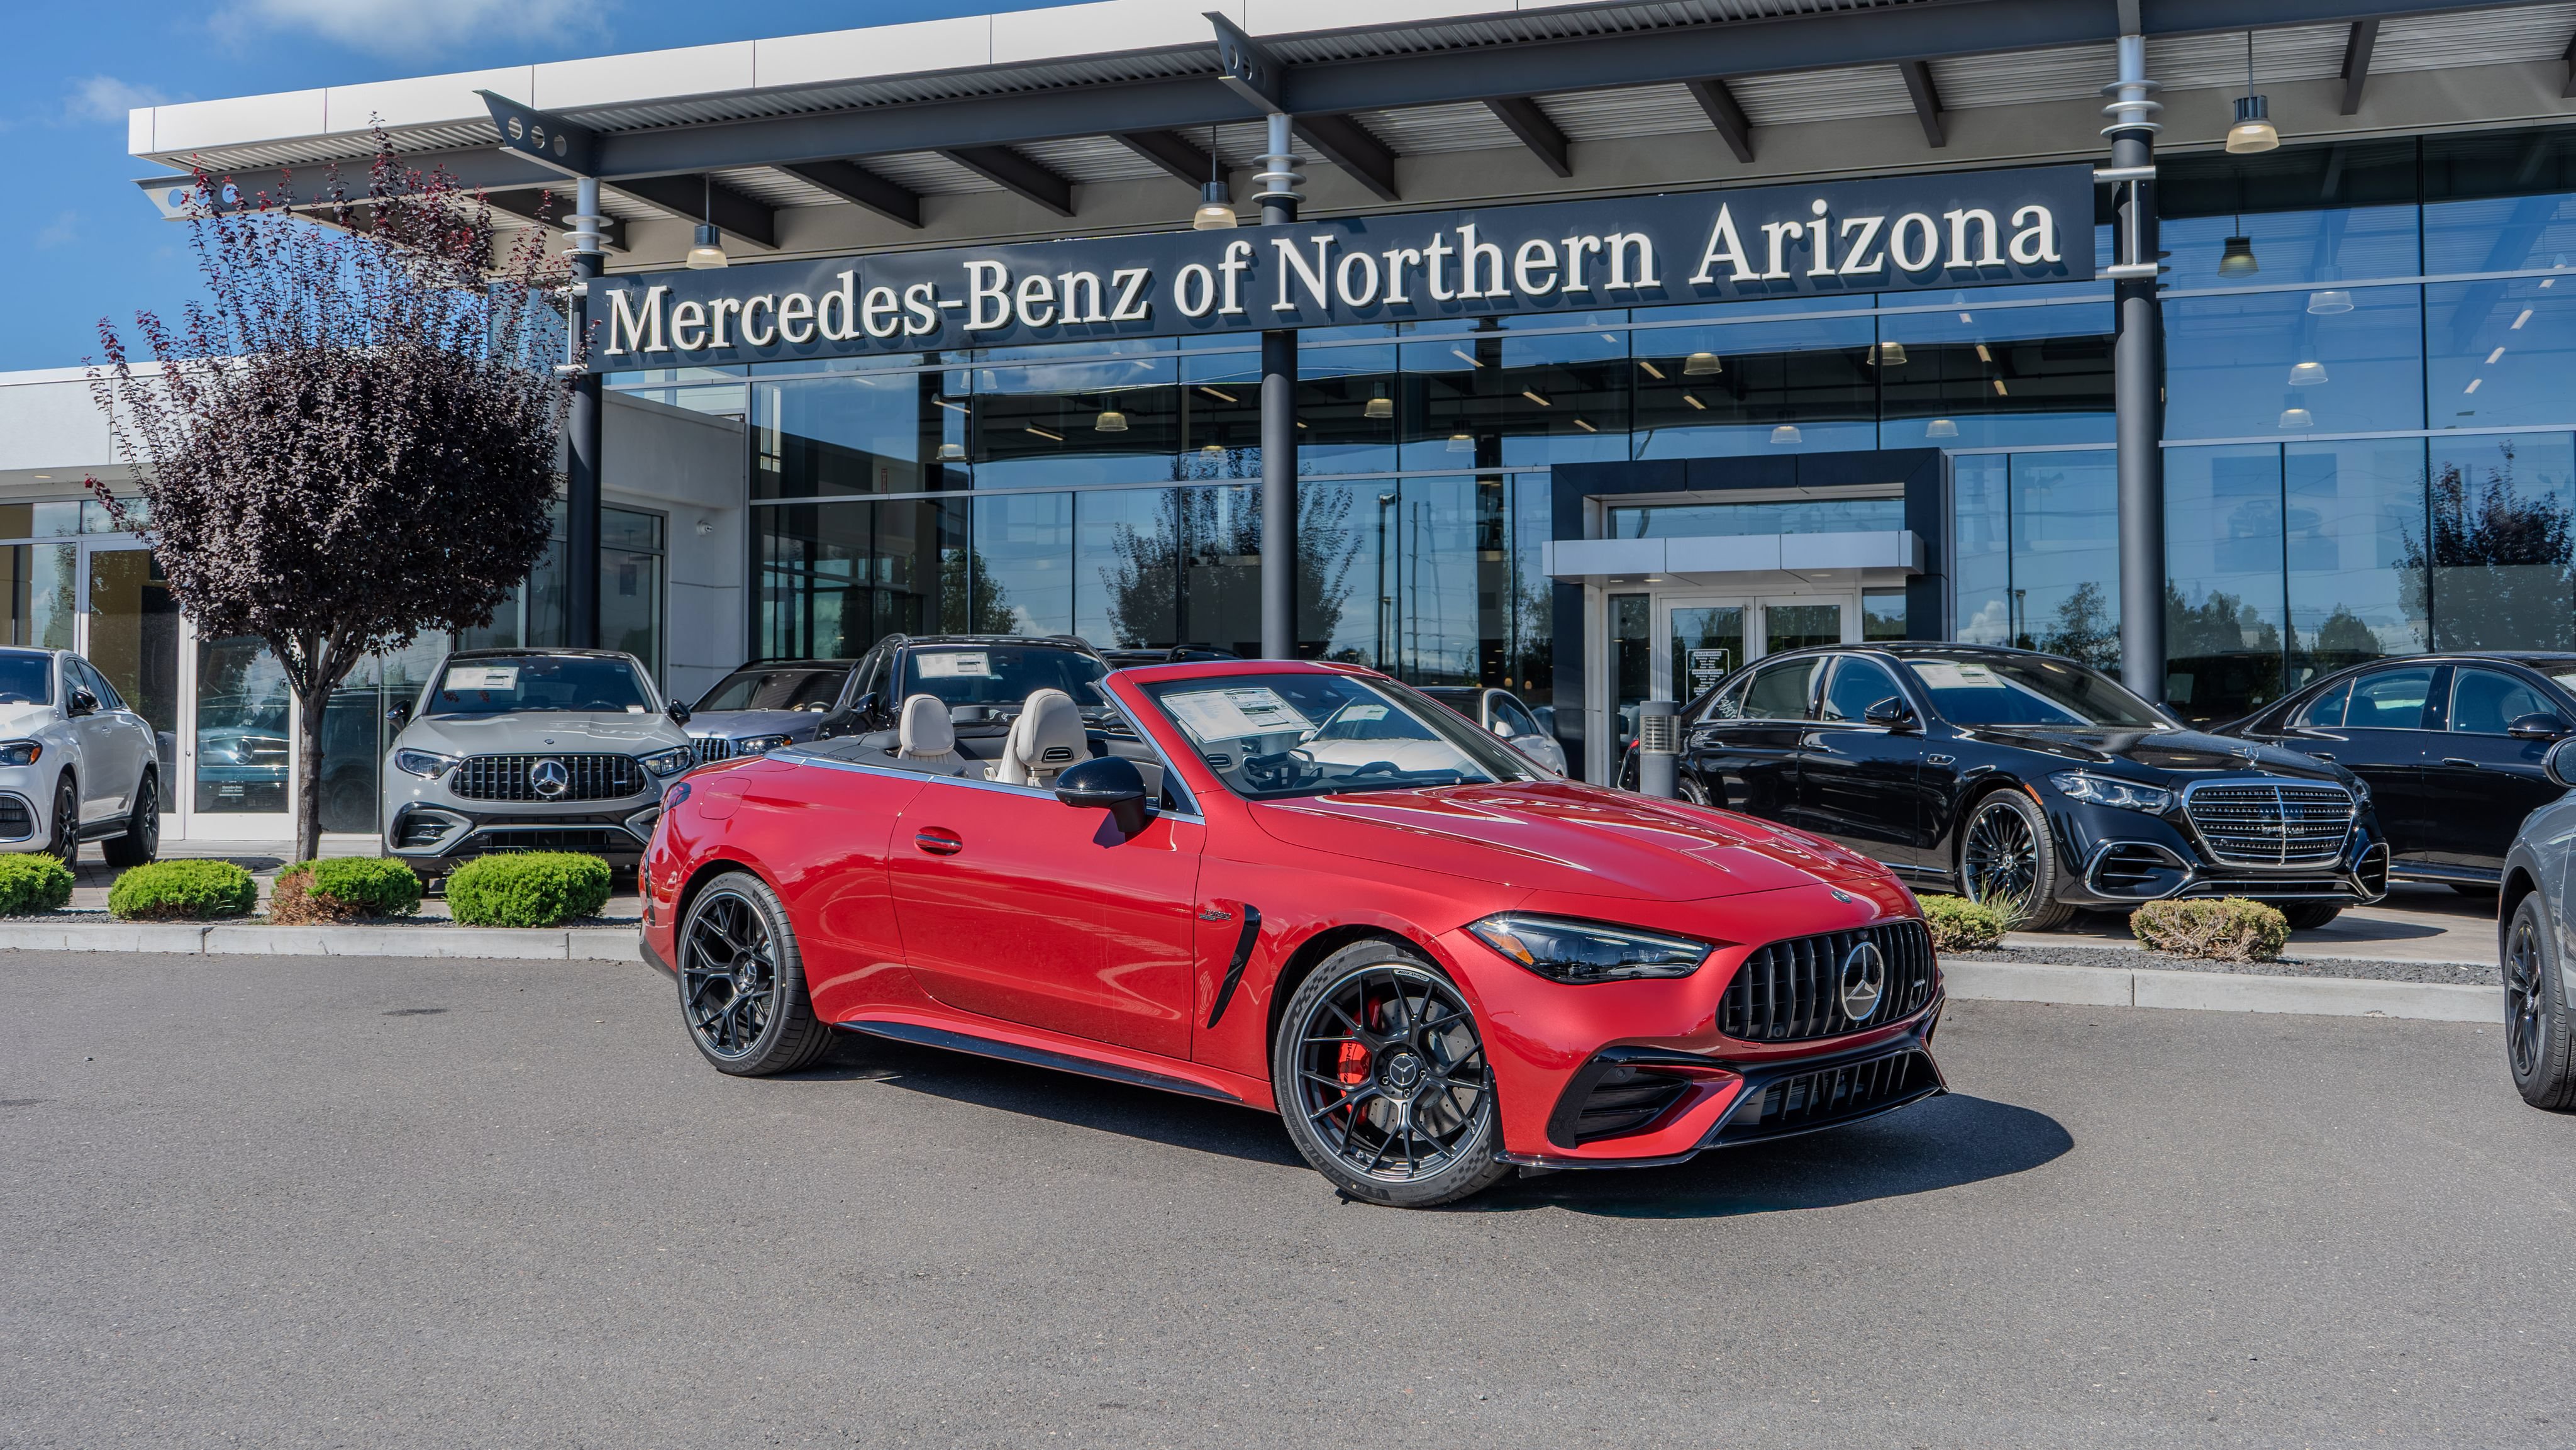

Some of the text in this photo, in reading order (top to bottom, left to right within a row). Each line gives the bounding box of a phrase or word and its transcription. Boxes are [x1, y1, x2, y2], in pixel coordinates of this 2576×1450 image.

[604, 199, 2061, 355] Mercedes-Benz of Northern Arizona
[758, 899, 780, 939] MICHELIN
[1204, 909, 1231, 919] TURBO
[1407, 971, 1427, 981] AMG
[1282, 1088, 1292, 1113] SPORT
[1289, 1115, 1302, 1136] PILOT
[1304, 1142, 1368, 1194] MICHELIN
